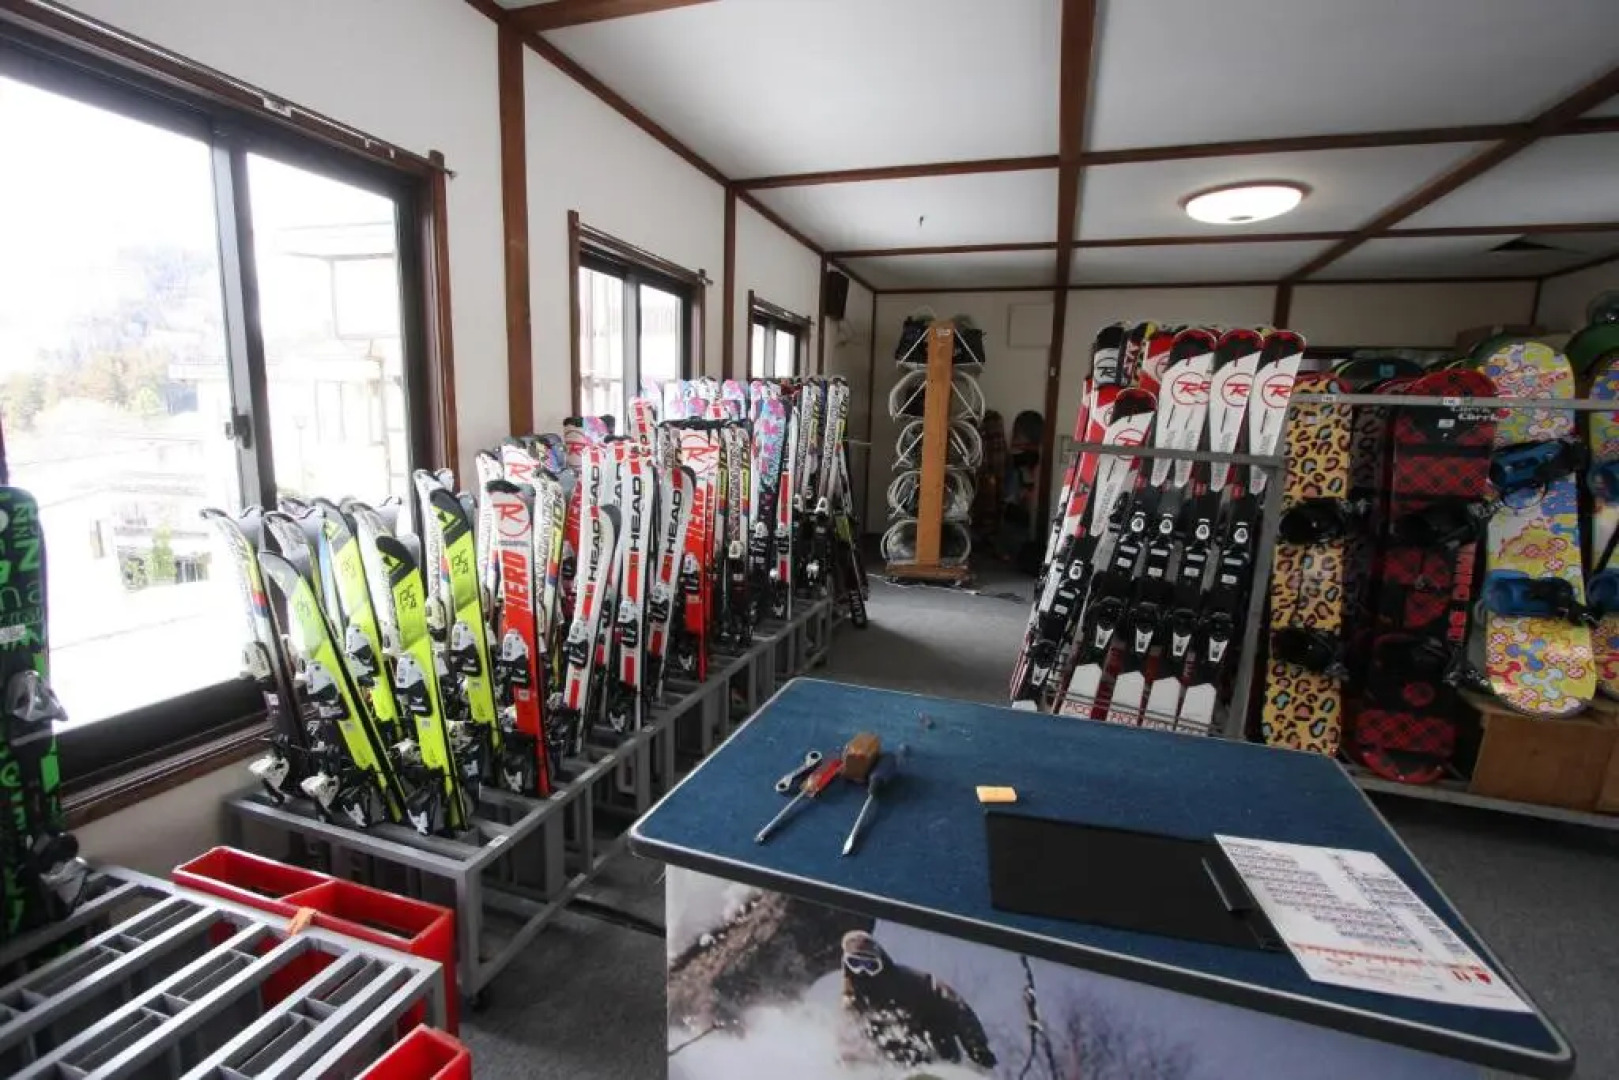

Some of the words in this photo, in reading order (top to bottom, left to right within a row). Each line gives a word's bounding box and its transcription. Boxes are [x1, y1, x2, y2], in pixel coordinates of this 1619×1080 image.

[631, 475, 643, 552] HEAD
[666, 489, 682, 554] HEAD
[502, 550, 529, 610] HERO
[588, 518, 601, 582] HEAD
